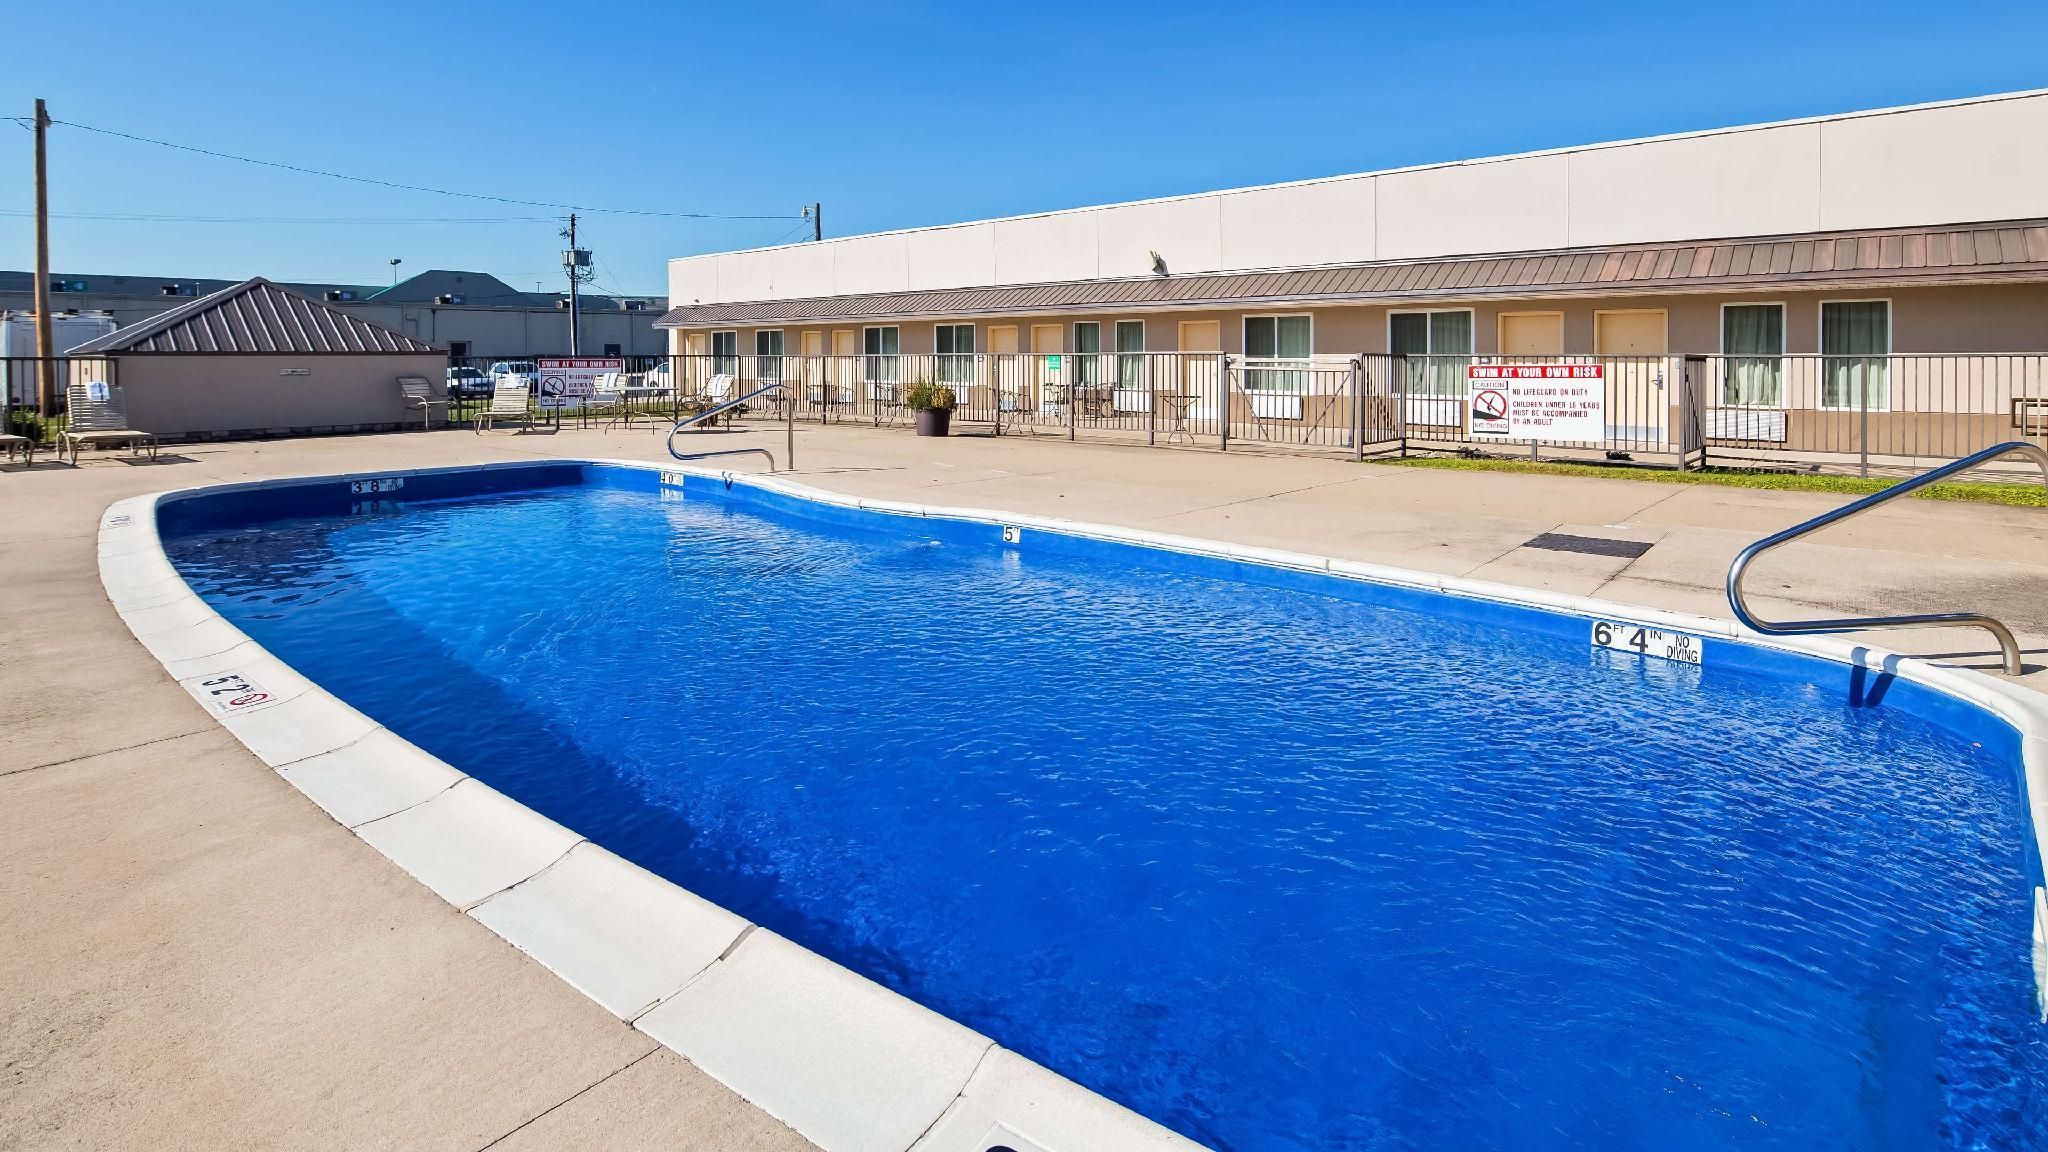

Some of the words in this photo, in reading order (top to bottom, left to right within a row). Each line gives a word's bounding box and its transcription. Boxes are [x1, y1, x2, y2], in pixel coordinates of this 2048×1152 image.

[1472, 366, 1499, 378] SWIM
[1501, 366, 1513, 378] AT
[1515, 366, 1542, 378] YOUR
[1546, 366, 1570, 378] OWN
[1573, 366, 1598, 378] RISK
[1512, 388, 1521, 396] NO
[1523, 388, 1557, 396] LIFEGUARD
[1559, 388, 1569, 396] ON
[1571, 388, 1588, 397] DUTY
[1545, 401, 1566, 409] UNDER
[1579, 401, 1600, 410] YEARS
[1542, 410, 1588, 418] ACCOMPANIED
[1533, 418, 1553, 426] ADULT
[352, 480, 362, 493] 3
[371, 480, 380, 492] 8
[1005, 526, 1013, 541] 5
[1594, 621, 1612, 646] 6
[1613, 624, 1626, 634] FT
[1629, 628, 1649, 653] 4
[1650, 629, 1662, 641] IN
[1675, 635, 1690, 649] NO
[1666, 645, 1698, 663] DIVING
[211, 684, 251, 696] 2
